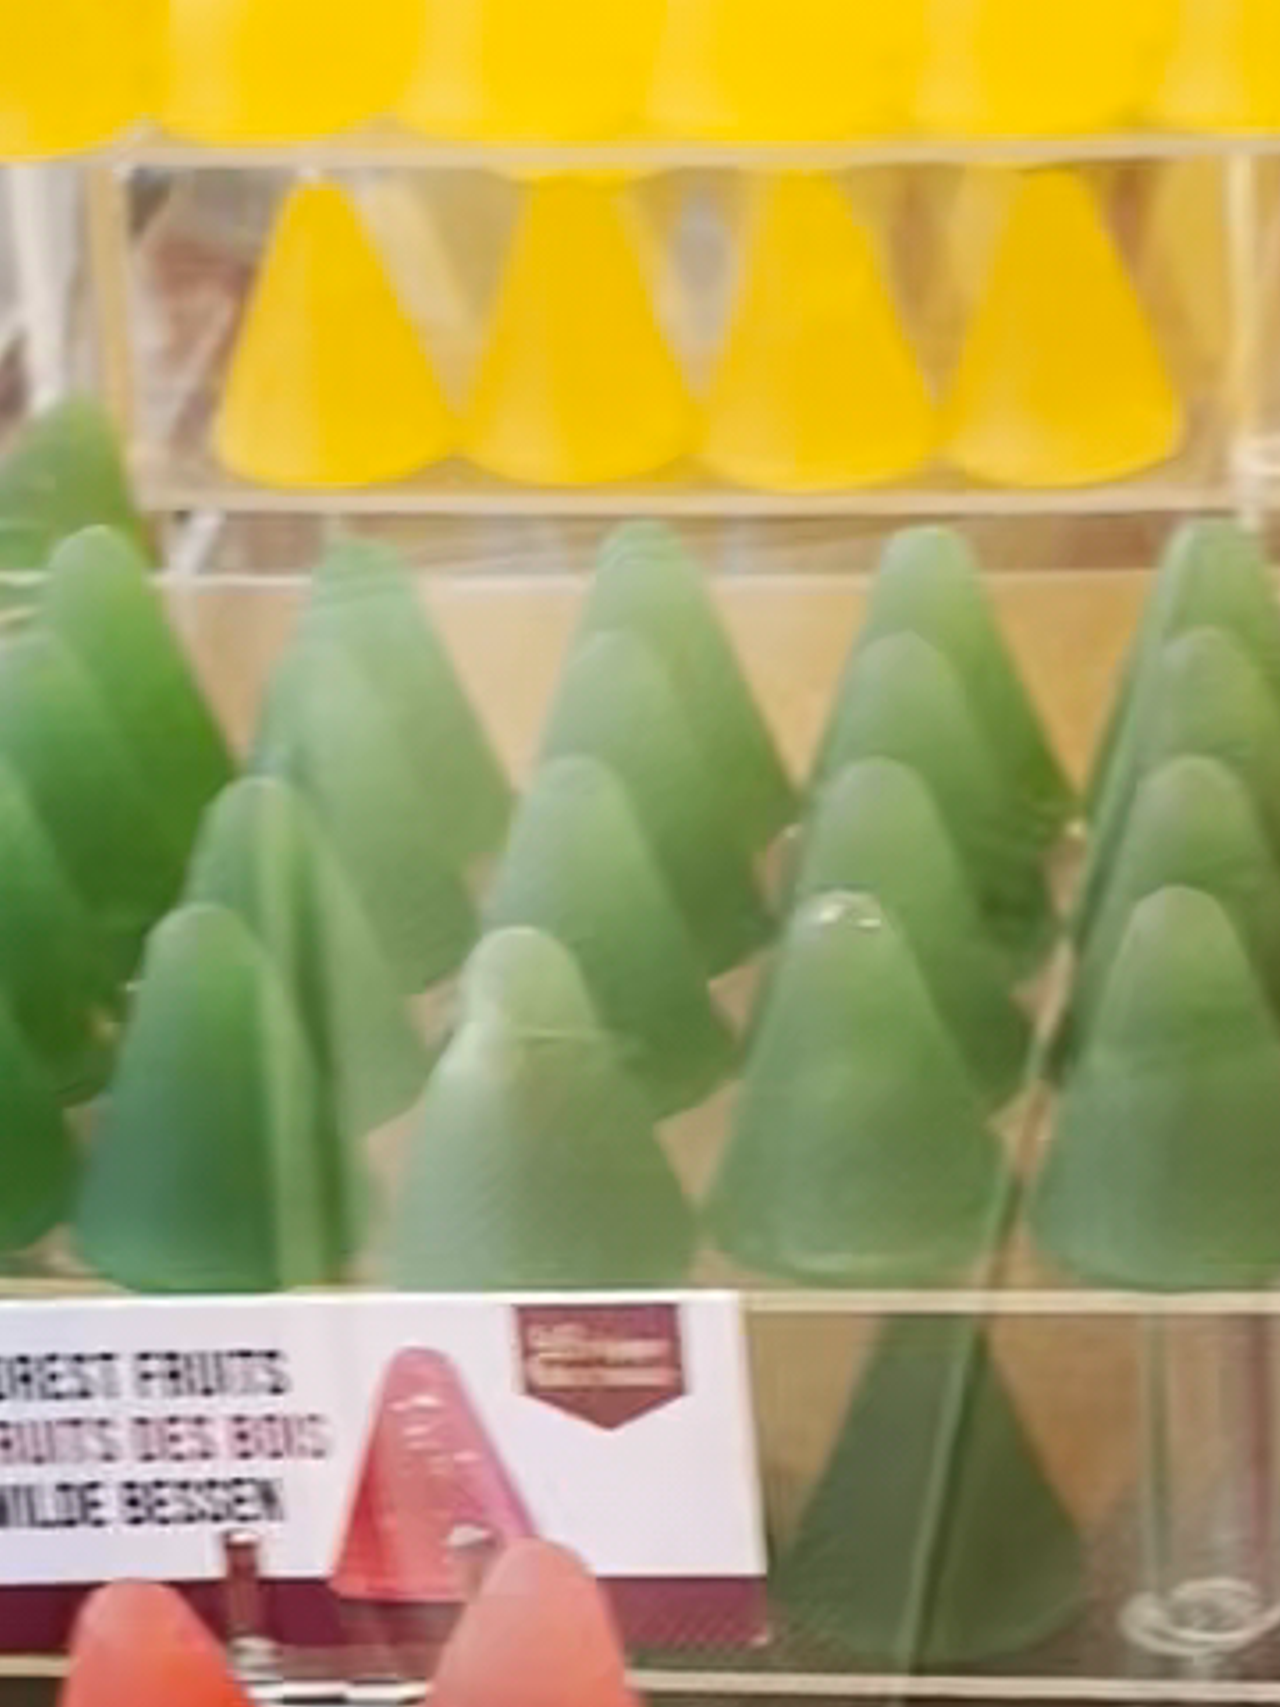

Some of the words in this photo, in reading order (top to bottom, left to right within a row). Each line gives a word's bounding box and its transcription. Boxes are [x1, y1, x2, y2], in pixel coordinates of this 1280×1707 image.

[135, 1349, 288, 1397] FRUITS
[131, 1415, 213, 1462] DES
[229, 1413, 329, 1460] BOIS
[123, 1478, 283, 1526] BESSEN
